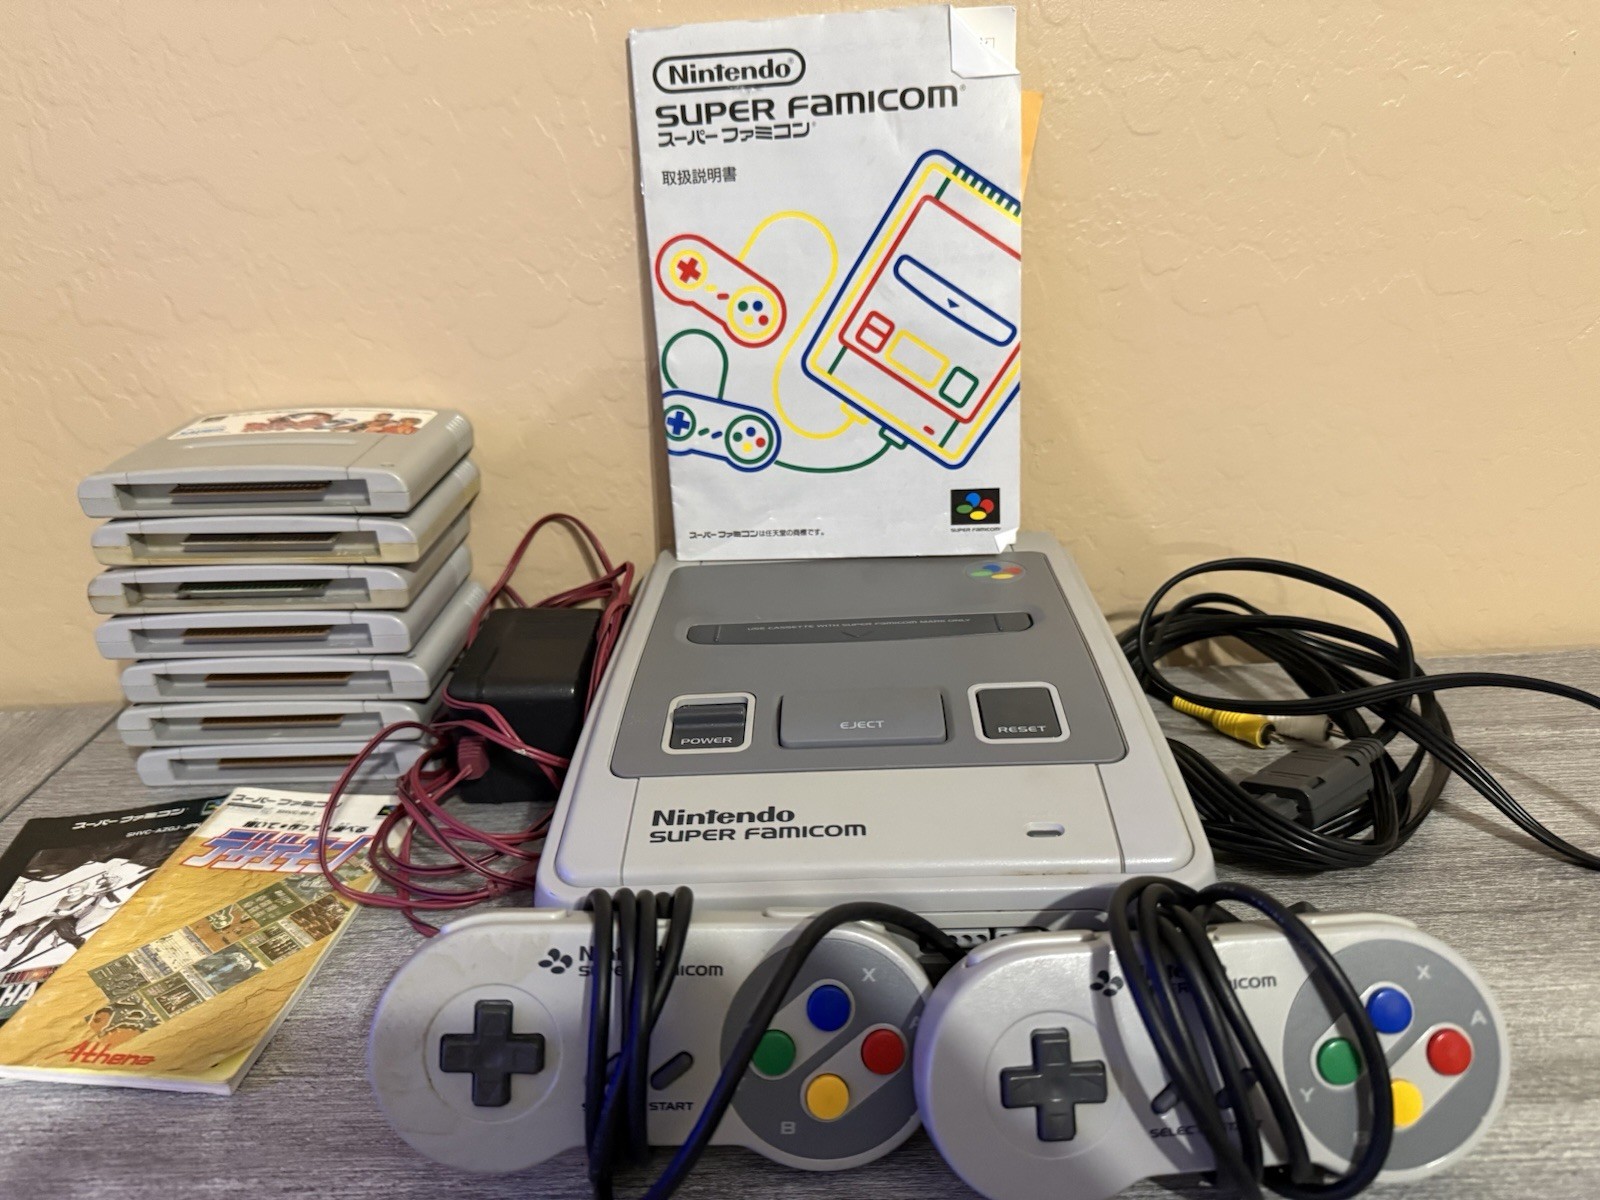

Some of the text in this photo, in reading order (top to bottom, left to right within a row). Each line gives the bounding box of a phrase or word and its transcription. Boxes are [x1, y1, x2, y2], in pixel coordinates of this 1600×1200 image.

[668, 58, 792, 86] Nintendo
[655, 98, 776, 128] SUPER
[661, 166, 737, 186] 取扱説明書
[840, 720, 885, 729] EJECT
[998, 725, 1046, 734] RESET
[680, 736, 733, 745] POWER
[652, 806, 796, 826] Nintendo
[649, 828, 737, 843] SUPER
[862, 967, 876, 982] X
[1416, 965, 1432, 981] X
[1470, 1010, 1487, 1026] A
[45, 1040, 156, 1066] Athena
[1300, 1087, 1314, 1103] Y
[649, 1102, 694, 1111] START
[780, 1121, 796, 1135] B
[1149, 1125, 1199, 1138] SELEC
